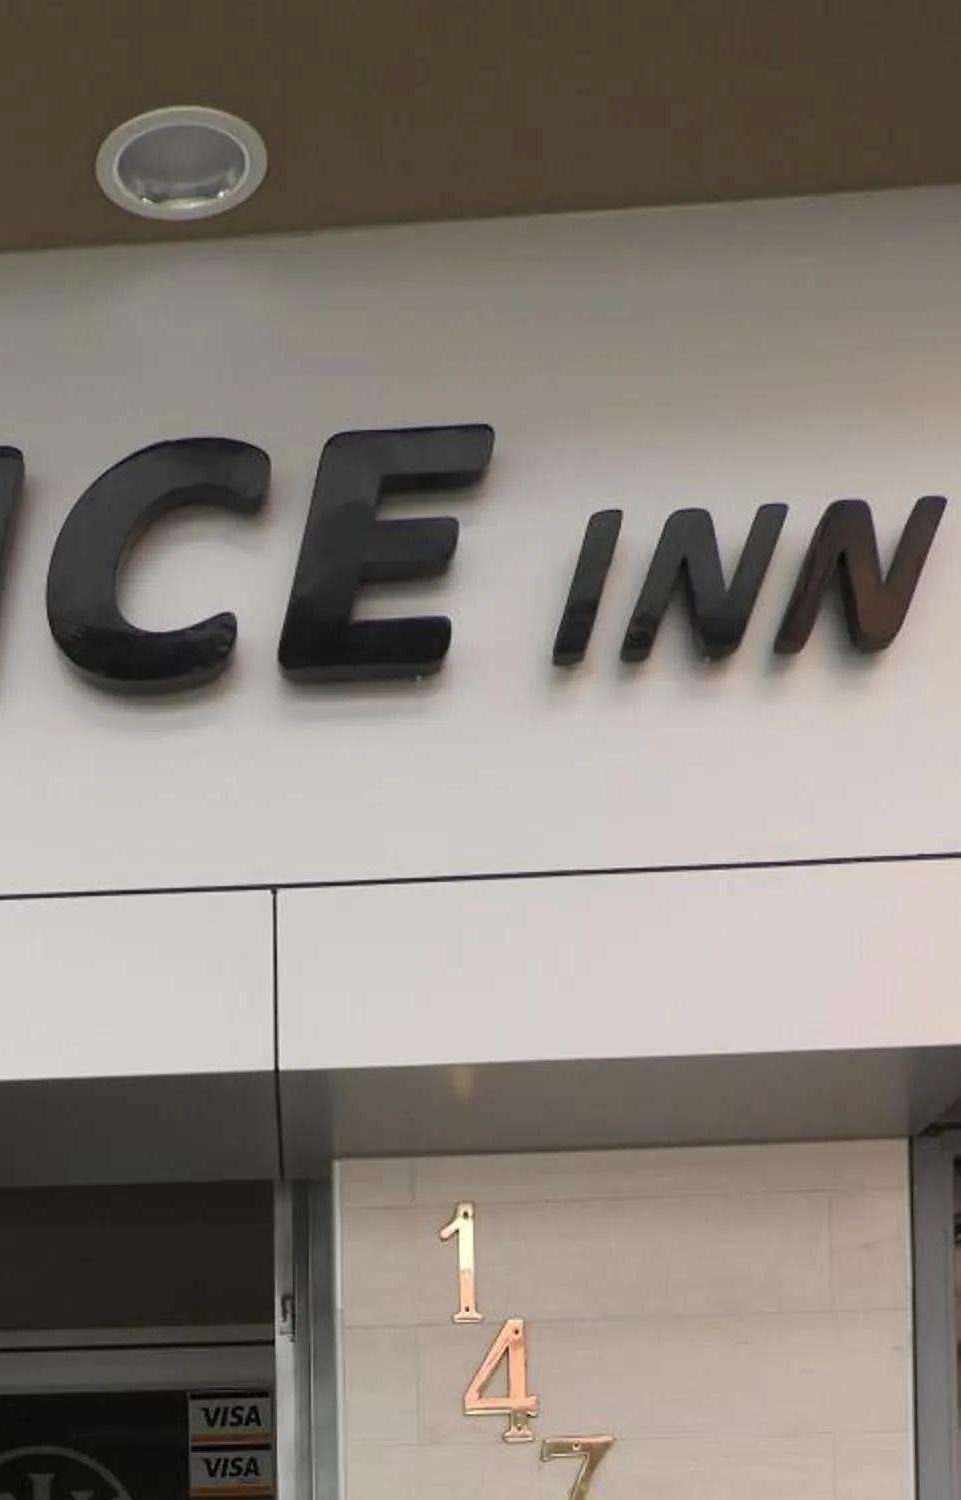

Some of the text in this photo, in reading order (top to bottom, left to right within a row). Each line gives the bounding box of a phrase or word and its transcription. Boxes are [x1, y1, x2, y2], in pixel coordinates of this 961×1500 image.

[552, 495, 948, 666] INN
[200, 1404, 262, 1428] VISA
[200, 1456, 261, 1479] VISA
